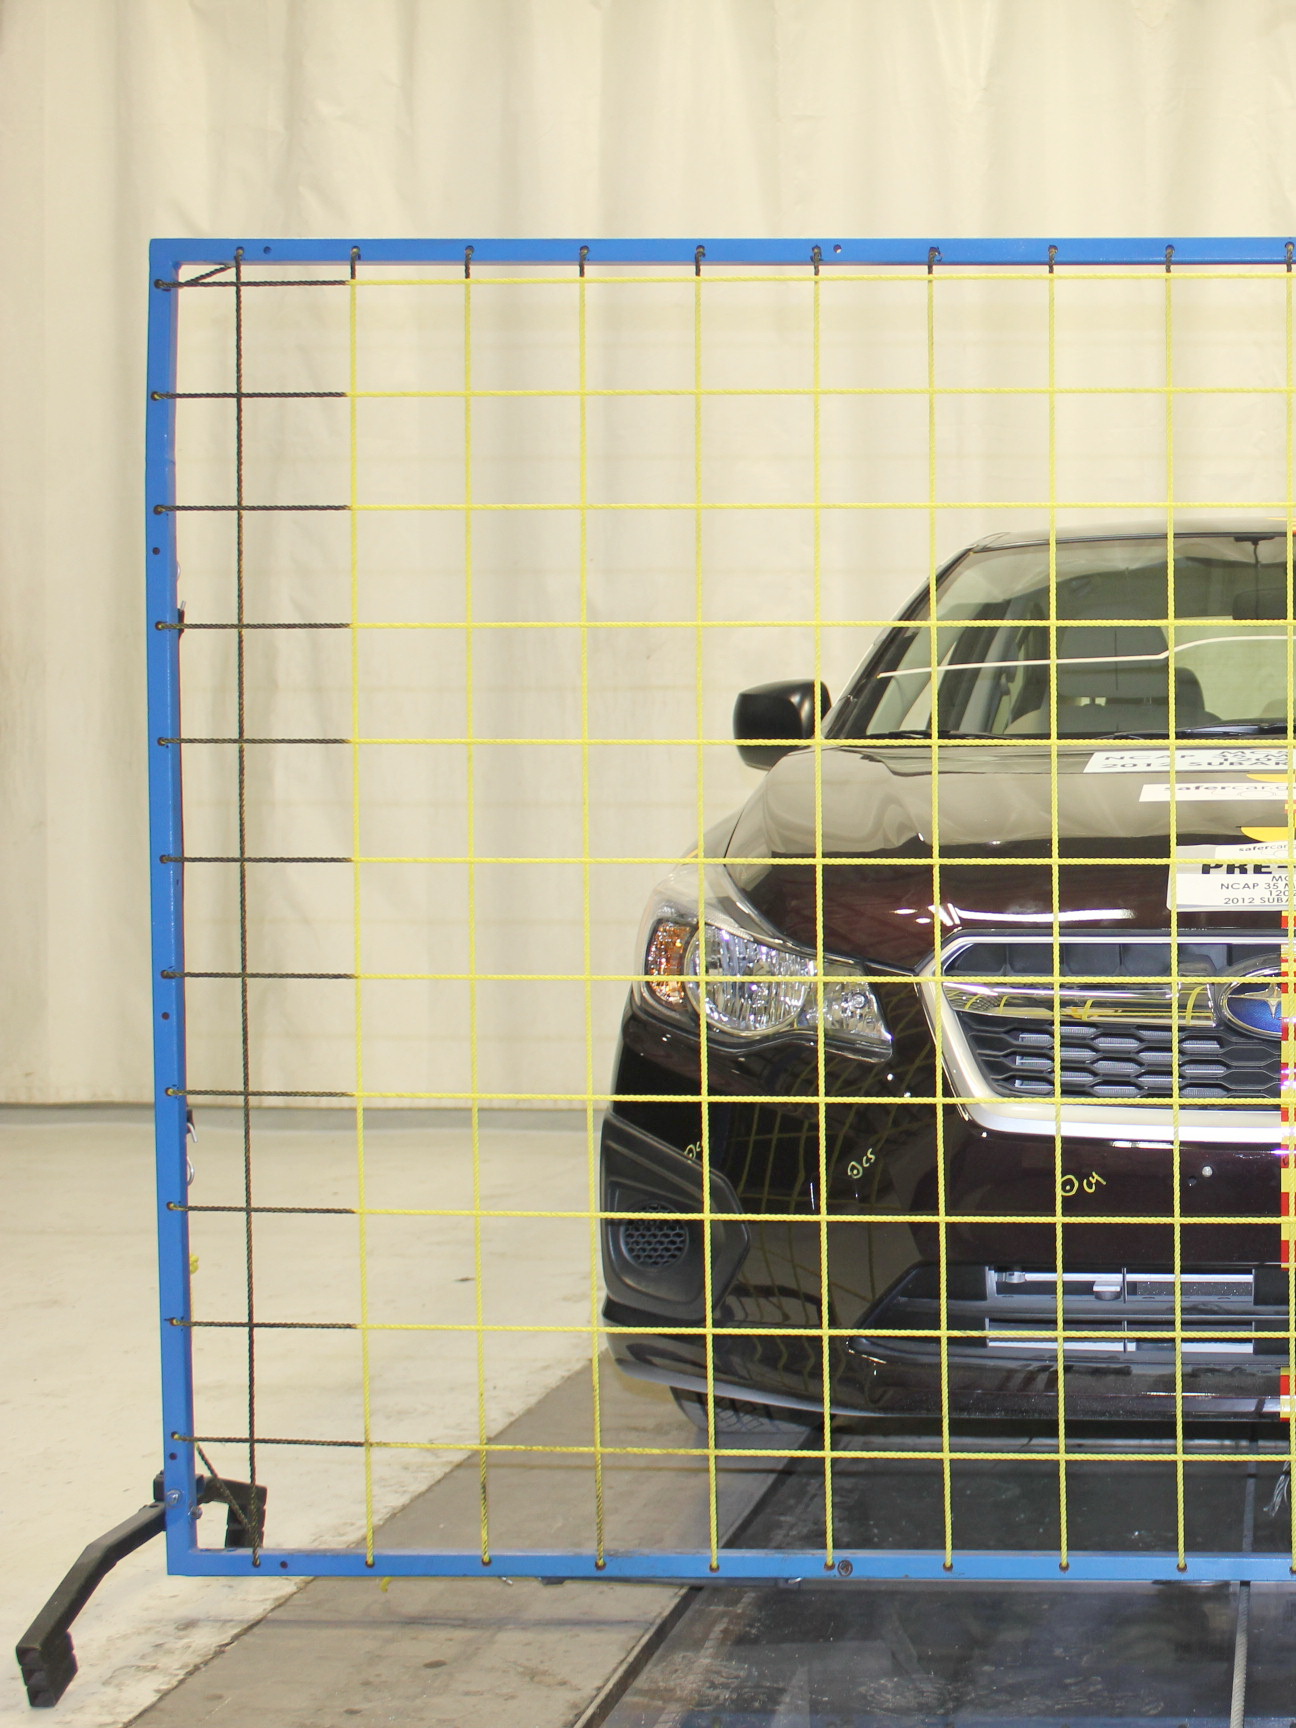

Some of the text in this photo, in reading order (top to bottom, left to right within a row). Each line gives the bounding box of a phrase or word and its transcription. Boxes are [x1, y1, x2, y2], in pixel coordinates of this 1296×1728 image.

[1220, 882, 1259, 890] NCAP
[1264, 882, 1279, 890] 35
[1224, 897, 1255, 905] 2012
